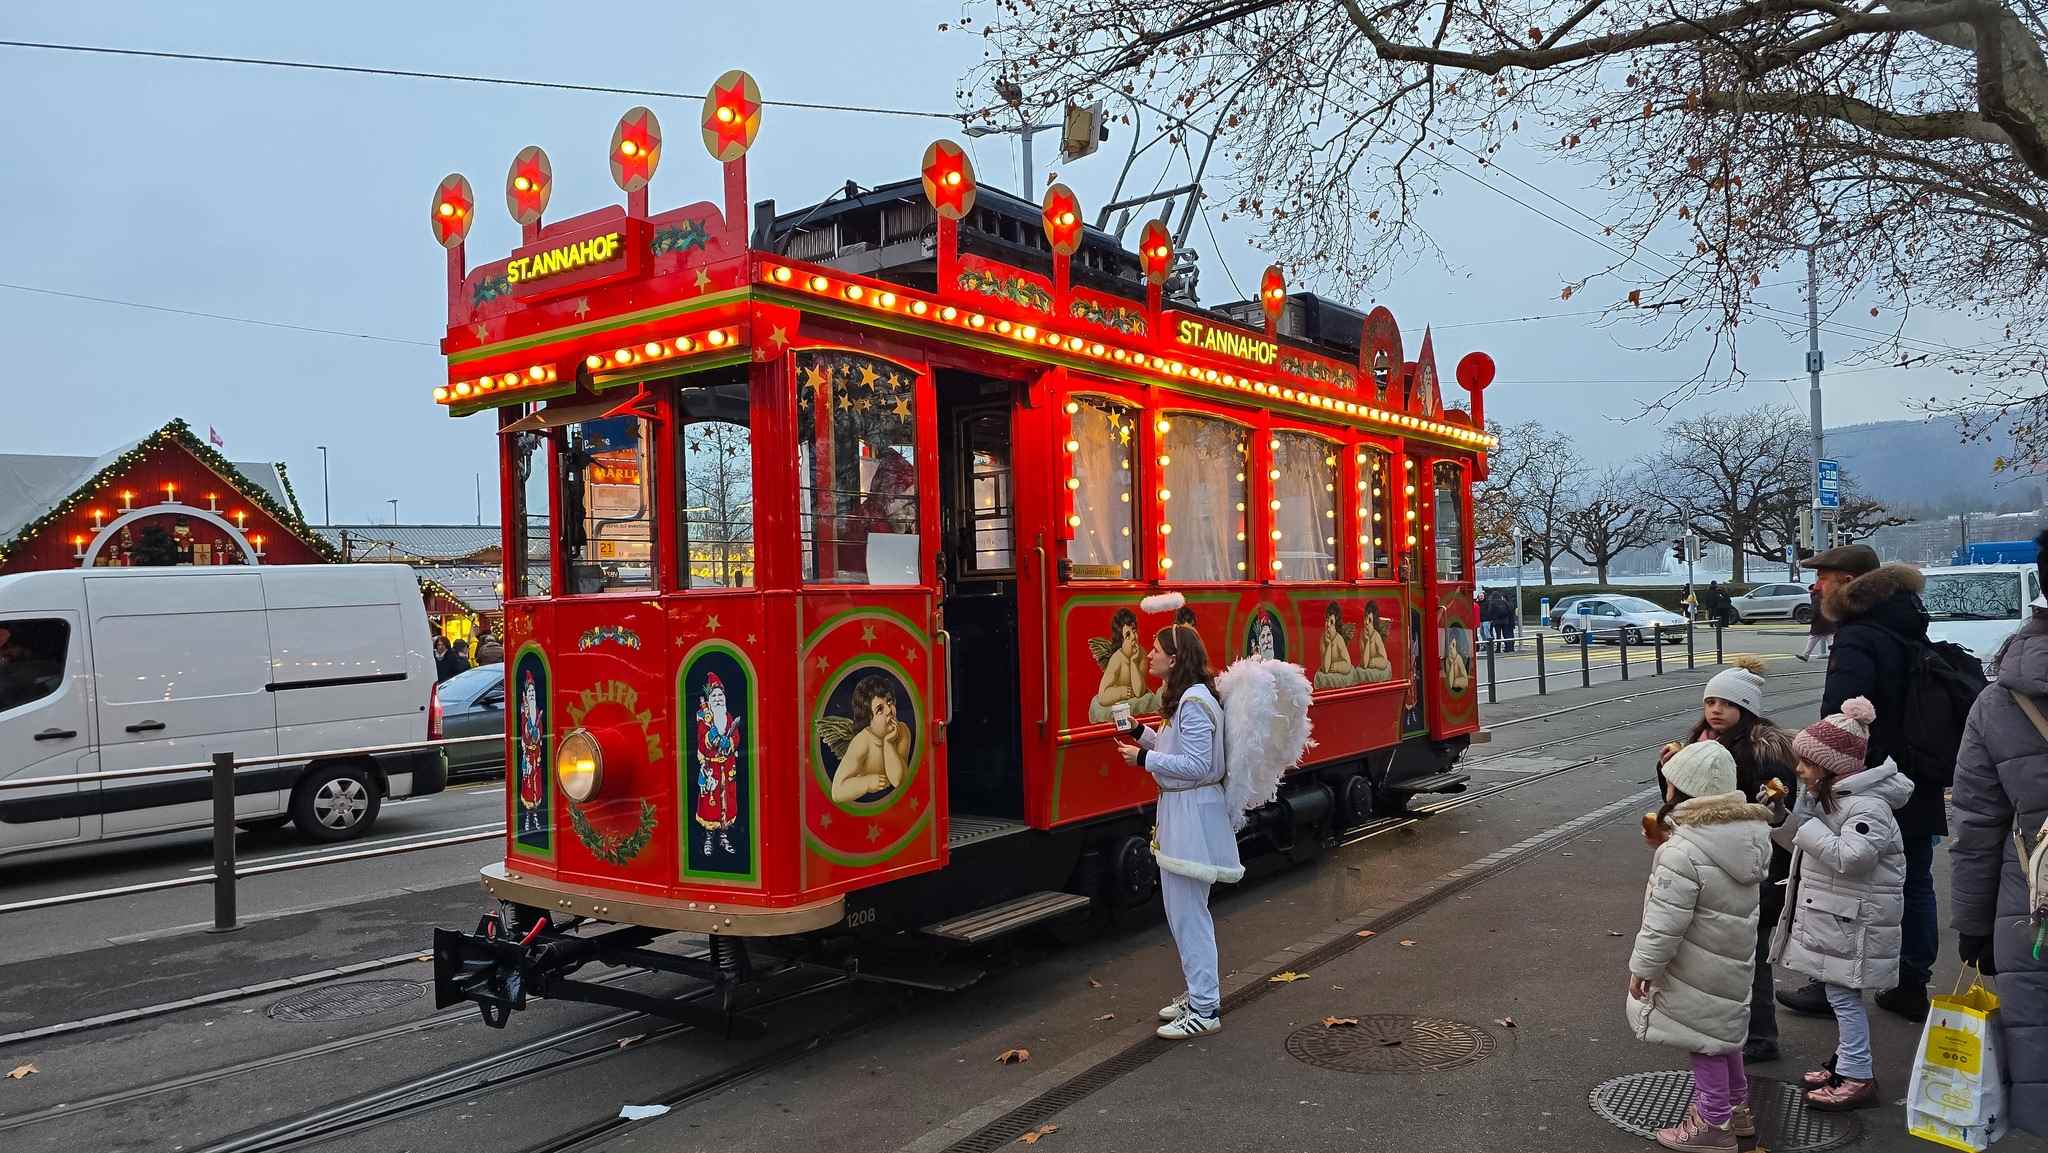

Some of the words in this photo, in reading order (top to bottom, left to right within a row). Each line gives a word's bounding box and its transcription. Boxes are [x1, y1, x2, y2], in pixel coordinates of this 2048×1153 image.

[507, 232, 618, 283] ST.ANNAHOF
[1180, 320, 1278, 364] ST.ANNAHOF
[564, 679, 664, 764] ÄRLITRAM
[847, 907, 876, 928] 1208
